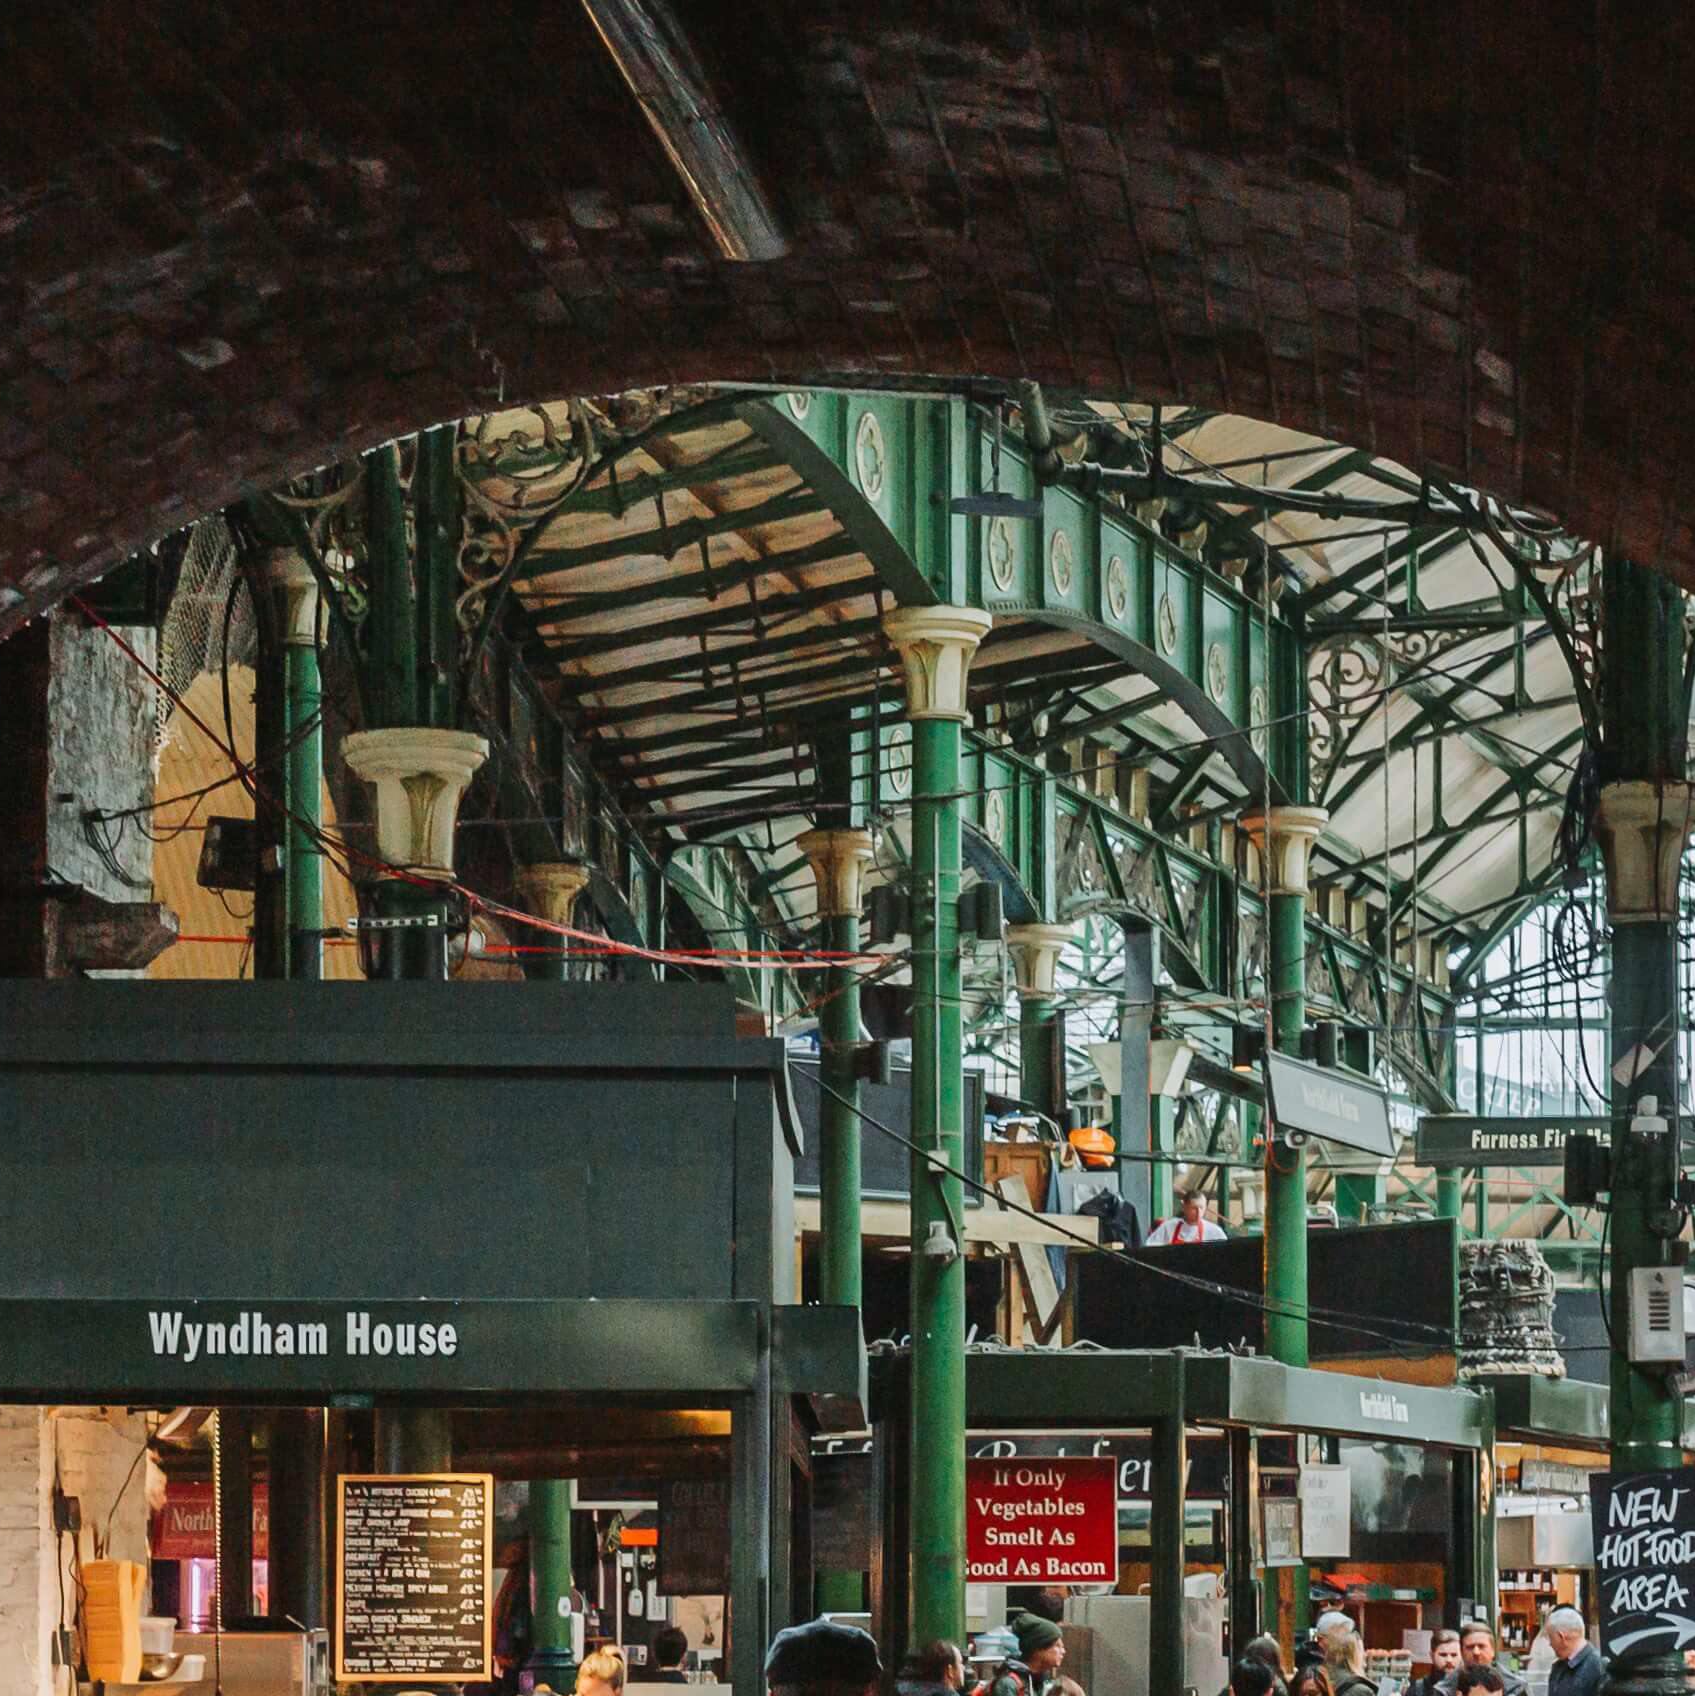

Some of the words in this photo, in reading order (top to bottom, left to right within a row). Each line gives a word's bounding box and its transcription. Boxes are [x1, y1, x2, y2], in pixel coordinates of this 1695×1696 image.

[1471, 1128, 1539, 1150] Furness
[1544, 1128, 1576, 1149] Fis
[148, 1311, 328, 1363] Wyndham
[345, 1311, 458, 1356] House
[993, 1468, 1010, 1486] If
[1015, 1468, 1067, 1491] Only
[975, 1496, 1086, 1522] Vegetables
[1608, 1487, 1691, 1528] NEW
[985, 1527, 1044, 1546] Smelt
[1049, 1528, 1076, 1546] As
[1596, 1530, 1650, 1569] HOT
[1013, 1558, 1041, 1577] As
[1046, 1557, 1106, 1577] Bacon
[1609, 1573, 1690, 1614] AREA
